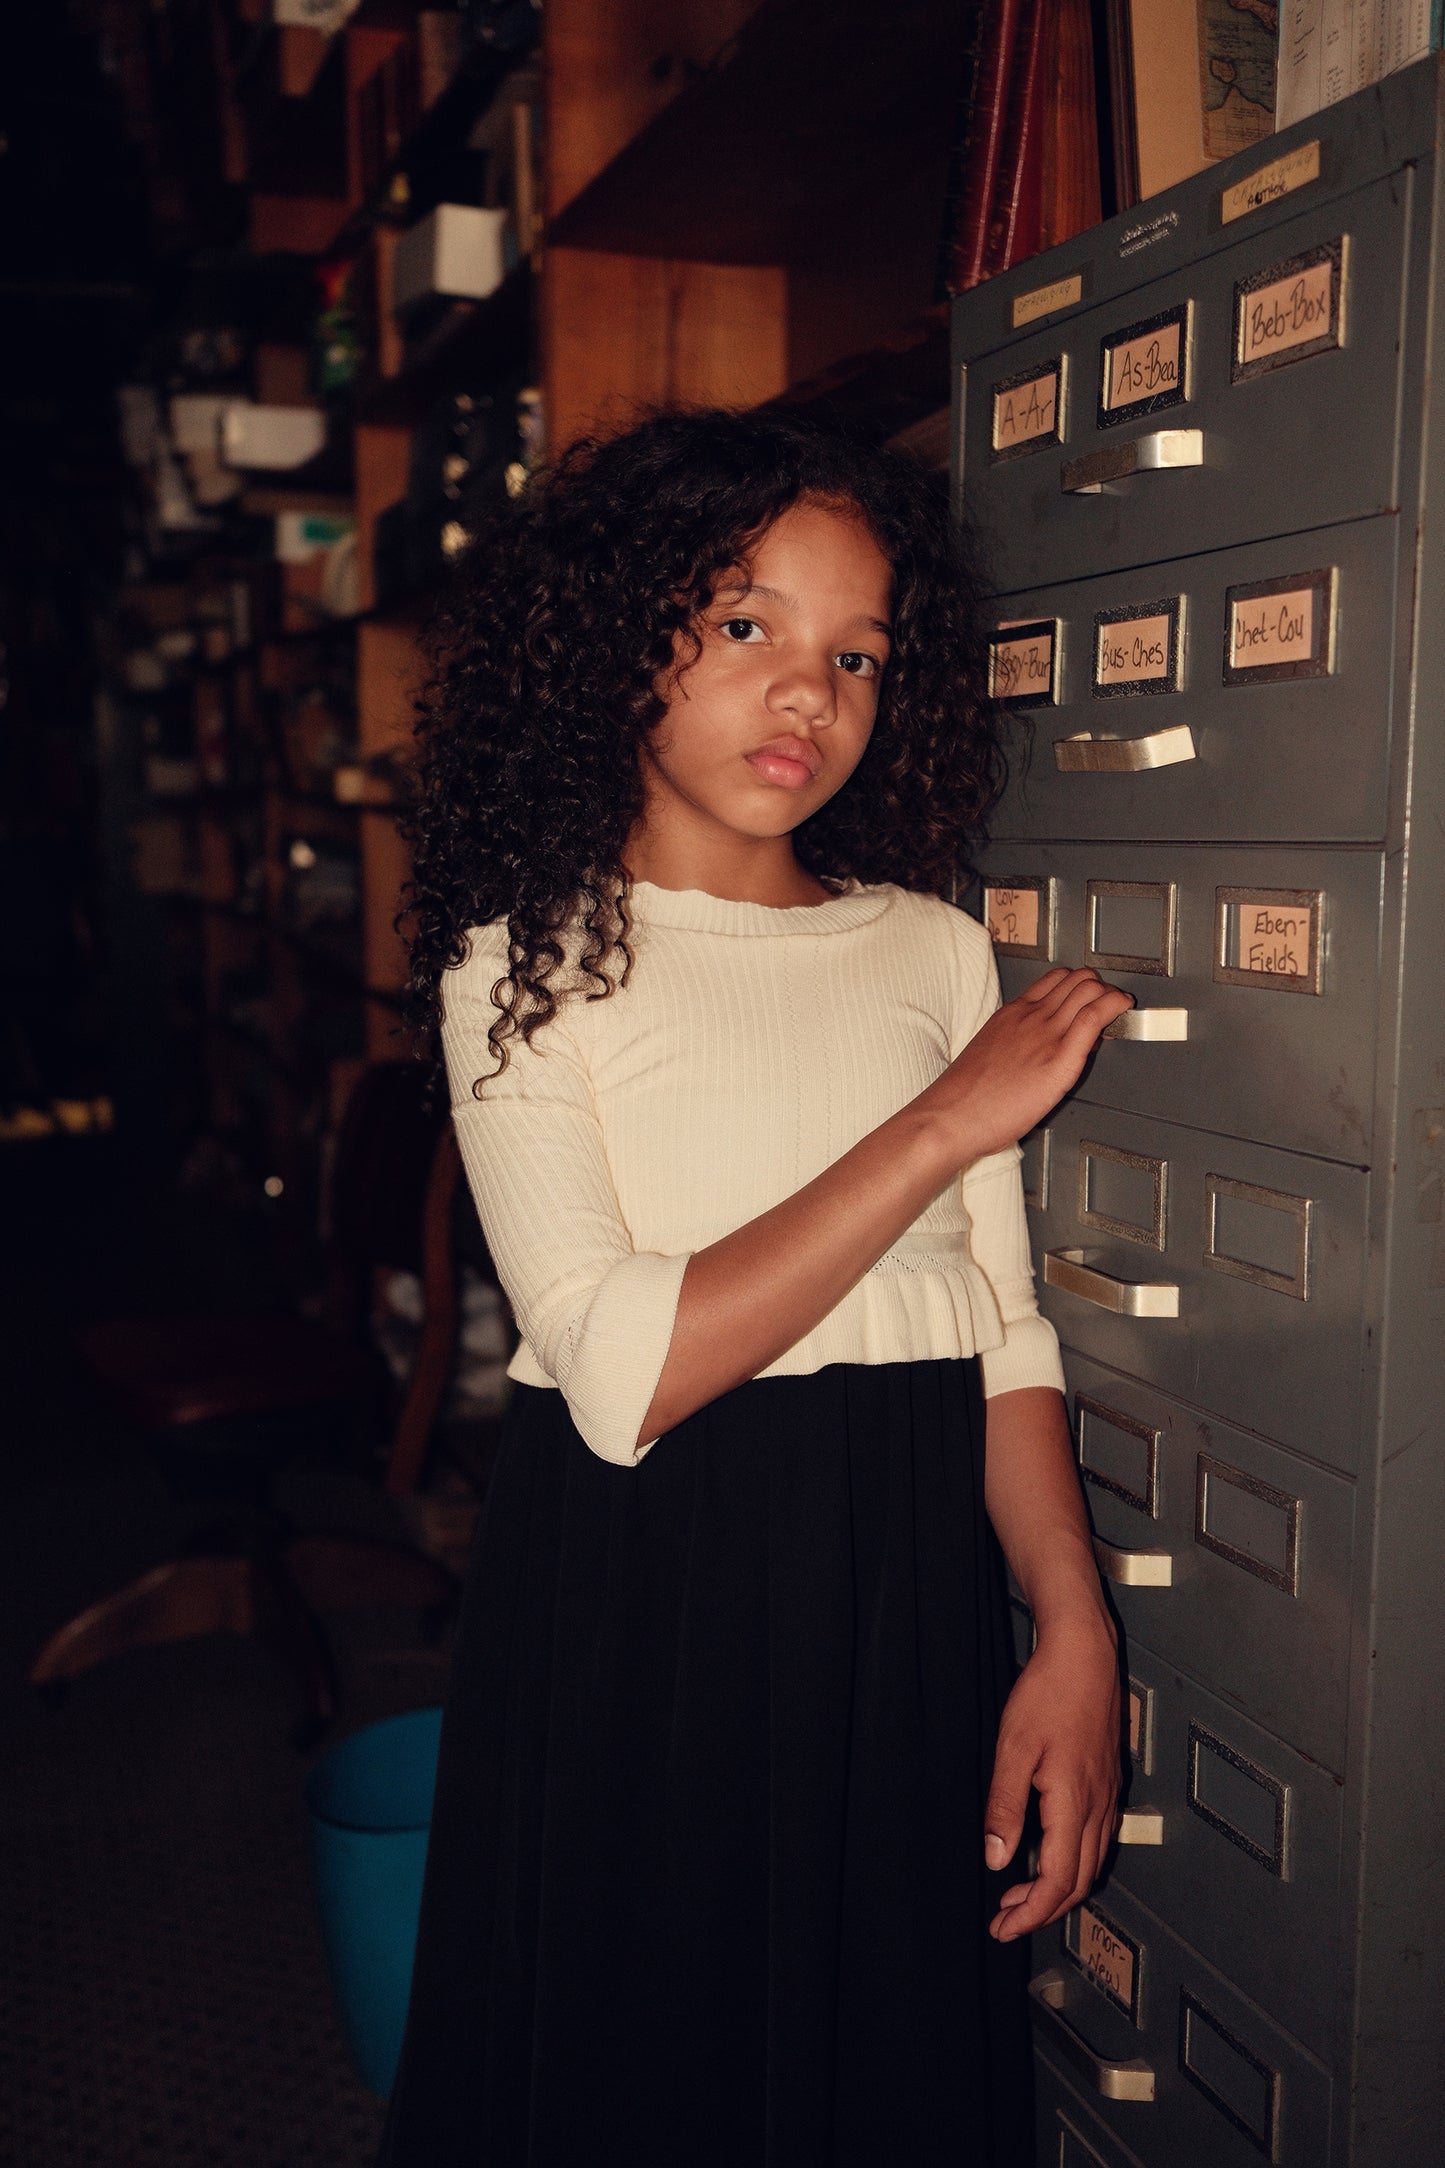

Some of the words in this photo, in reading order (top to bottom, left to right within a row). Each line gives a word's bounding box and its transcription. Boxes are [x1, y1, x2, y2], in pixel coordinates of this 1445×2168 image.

[1251, 278, 1326, 350] Beb-Box
[1117, 340, 1178, 395] As-Bea
[1001, 383, 1053, 435] A-Ar
[1235, 605, 1304, 650] Chet-Cou
[1254, 911, 1307, 937] Eben-
[1249, 943, 1298, 976] Fields
